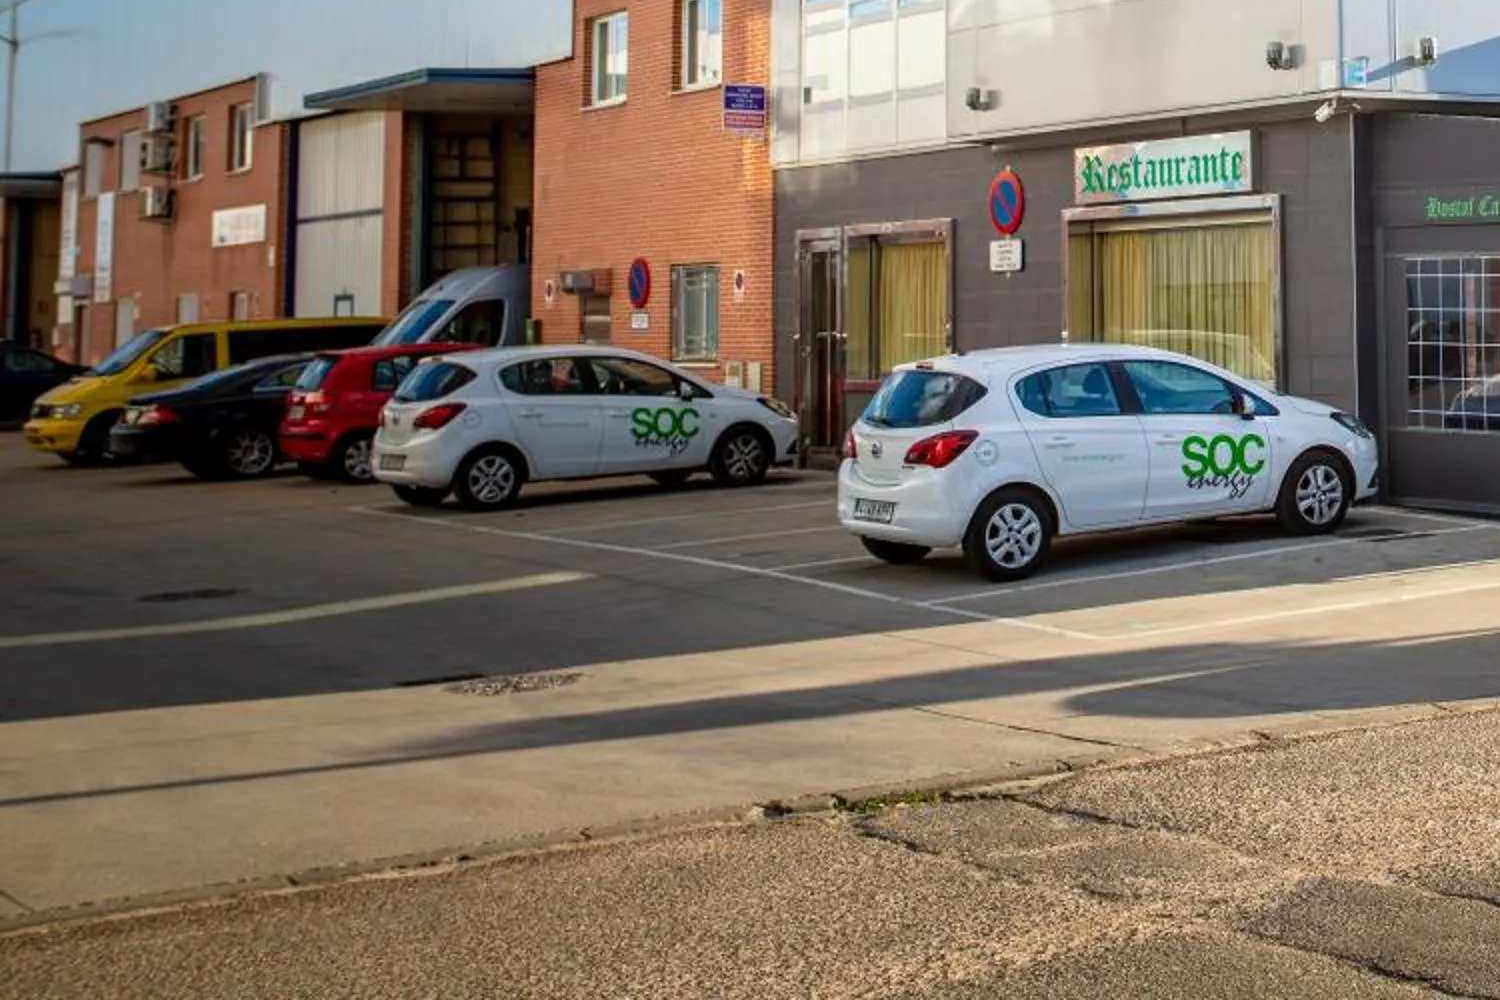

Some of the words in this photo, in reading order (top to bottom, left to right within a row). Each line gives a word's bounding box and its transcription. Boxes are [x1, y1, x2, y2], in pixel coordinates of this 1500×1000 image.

[1081, 147, 1243, 193] Restaurante
[1425, 196, 1476, 219] Hostal
[630, 407, 699, 438] SOC
[1182, 433, 1264, 477] SOC
[1186, 471, 1254, 499] energy
